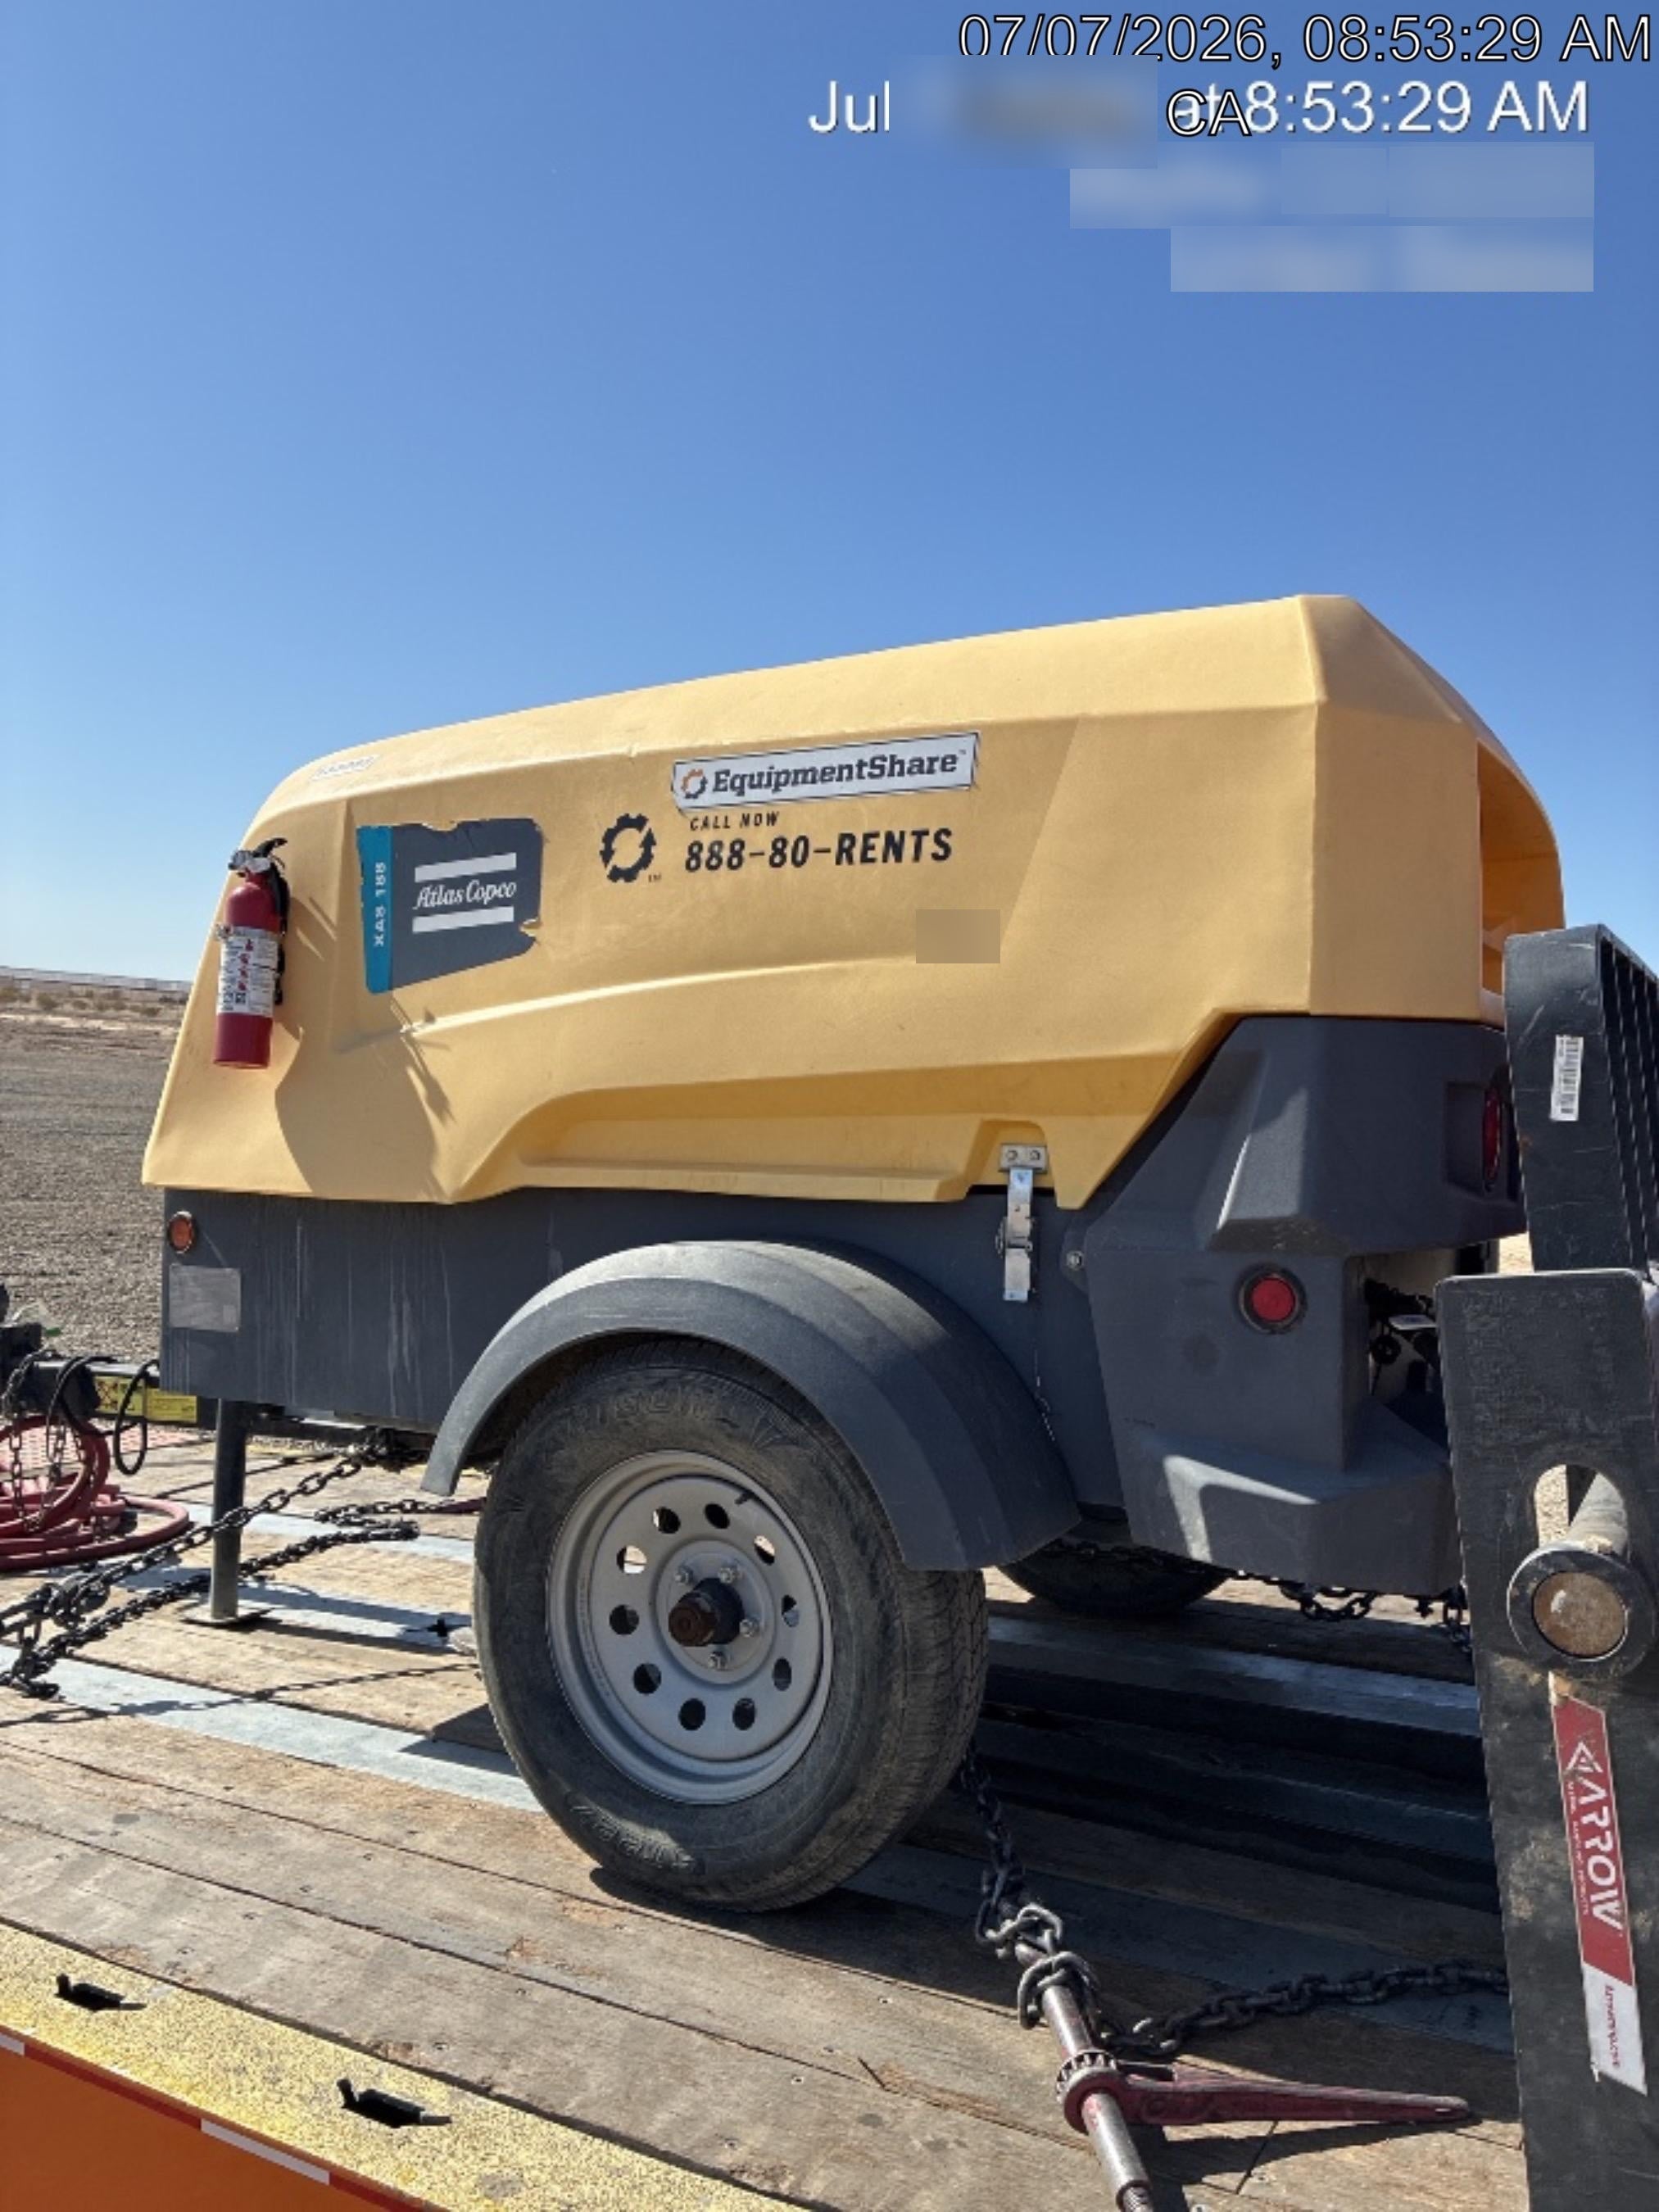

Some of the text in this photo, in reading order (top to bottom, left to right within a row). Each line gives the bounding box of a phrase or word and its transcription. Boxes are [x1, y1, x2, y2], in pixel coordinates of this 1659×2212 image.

[713, 753, 957, 797] EquipmentShare
[690, 811, 780, 832] CALL NOW
[685, 827, 953, 873] 888-80-RENTS
[412, 879, 517, 910] Atlas Copco
[1578, 1775, 1623, 1930] ARROW
